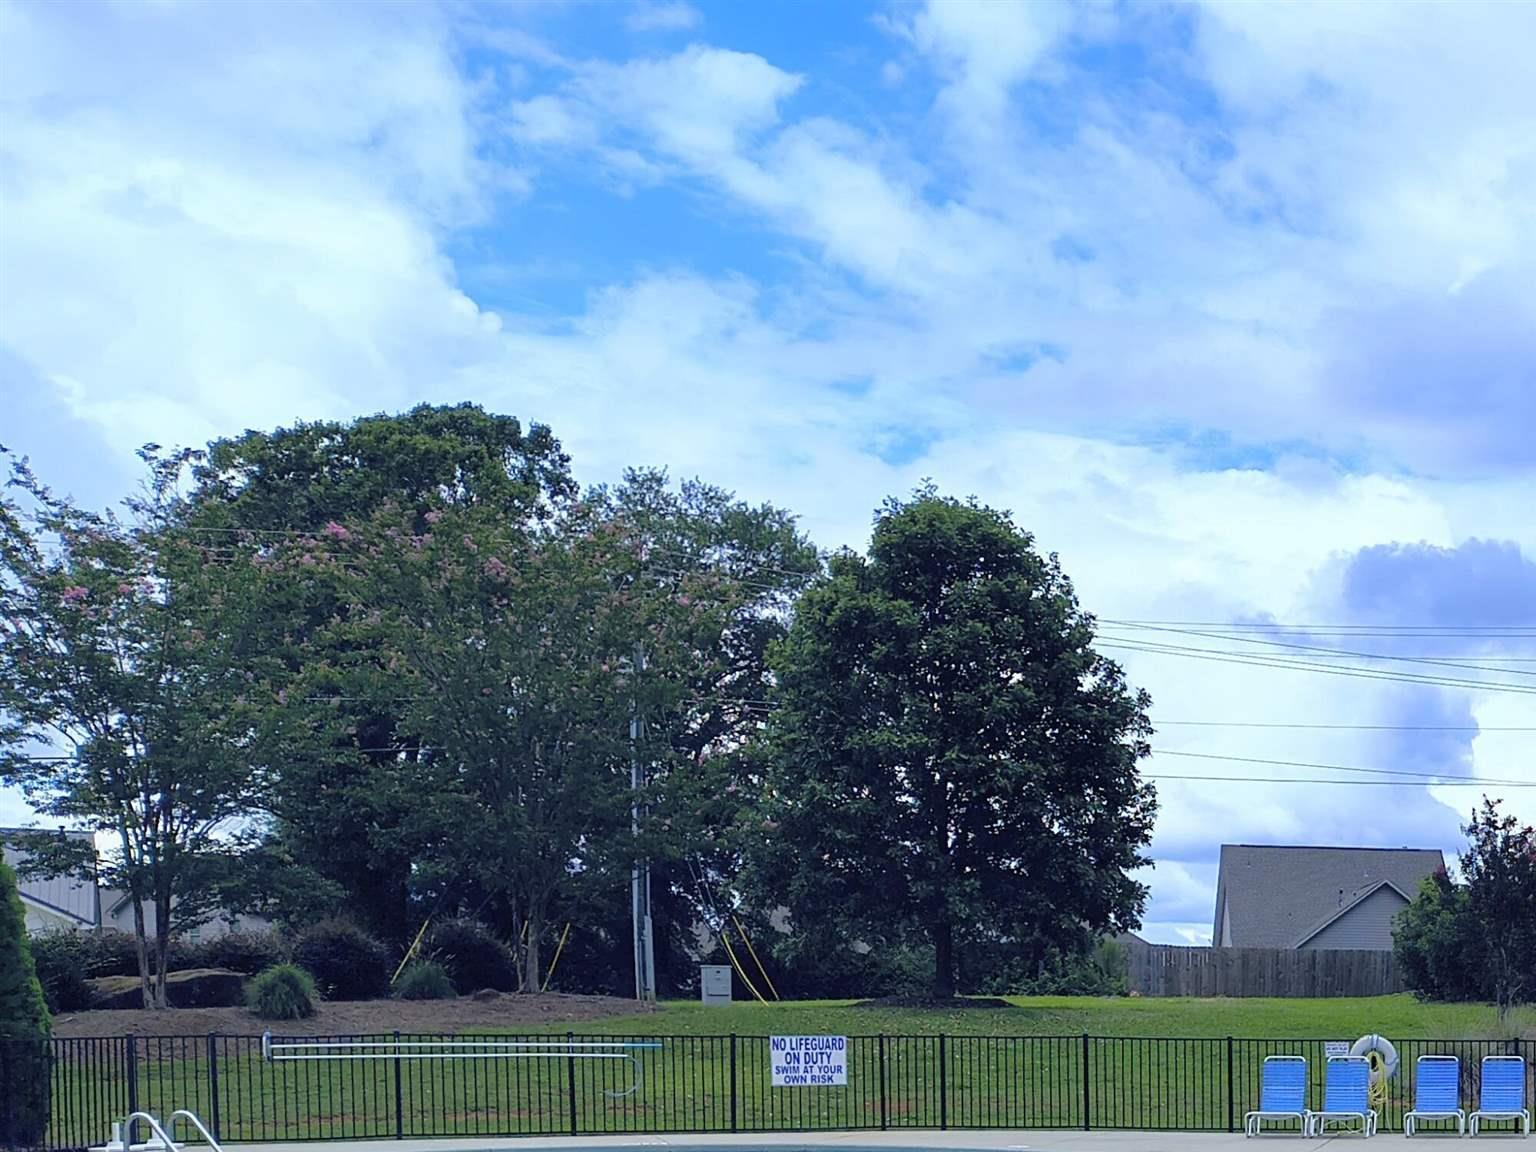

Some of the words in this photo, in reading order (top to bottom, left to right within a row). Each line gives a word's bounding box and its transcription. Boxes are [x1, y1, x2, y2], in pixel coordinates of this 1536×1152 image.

[772, 1038, 786, 1051] NO
[790, 1037, 844, 1051] LIFEGUARD
[785, 1052, 800, 1065] ON
[804, 1052, 832, 1064] DUTY
[775, 1066, 800, 1075] SWIM
[803, 1066, 814, 1074] AT
[817, 1065, 843, 1074] YOUR
[784, 1075, 807, 1084] OWN
[811, 1075, 834, 1083] RISK
